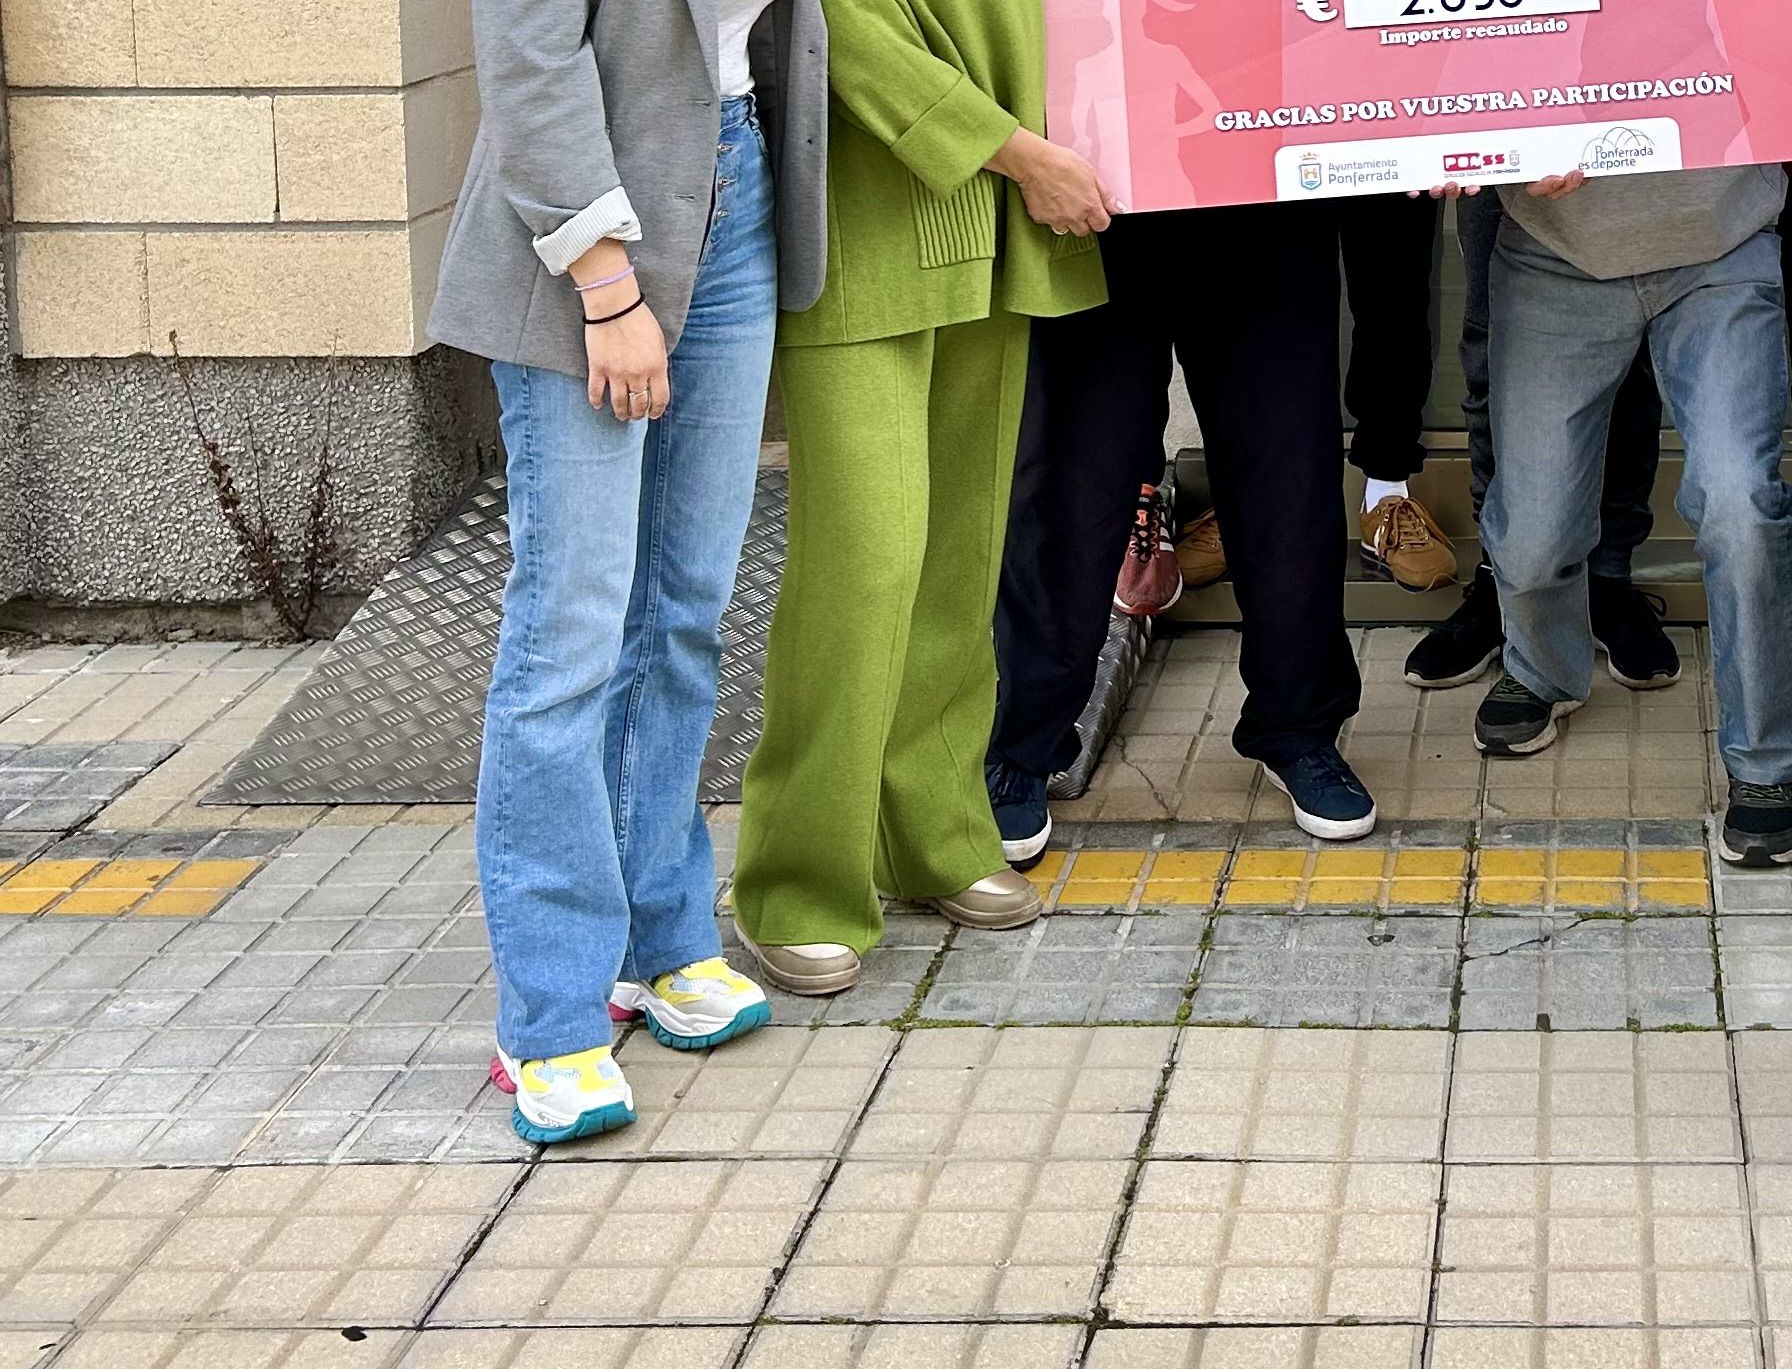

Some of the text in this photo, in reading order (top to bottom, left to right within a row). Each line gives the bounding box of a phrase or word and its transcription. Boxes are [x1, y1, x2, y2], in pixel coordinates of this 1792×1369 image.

[1379, 17, 1569, 47] Importe recaudado
[1214, 71, 1735, 131] GRACIAS POR VUESTRA PARTICIPACIÓN
[1595, 145, 1654, 164] Ponferrada
[1328, 158, 1400, 188] Ayuntamiento Ponferrada
